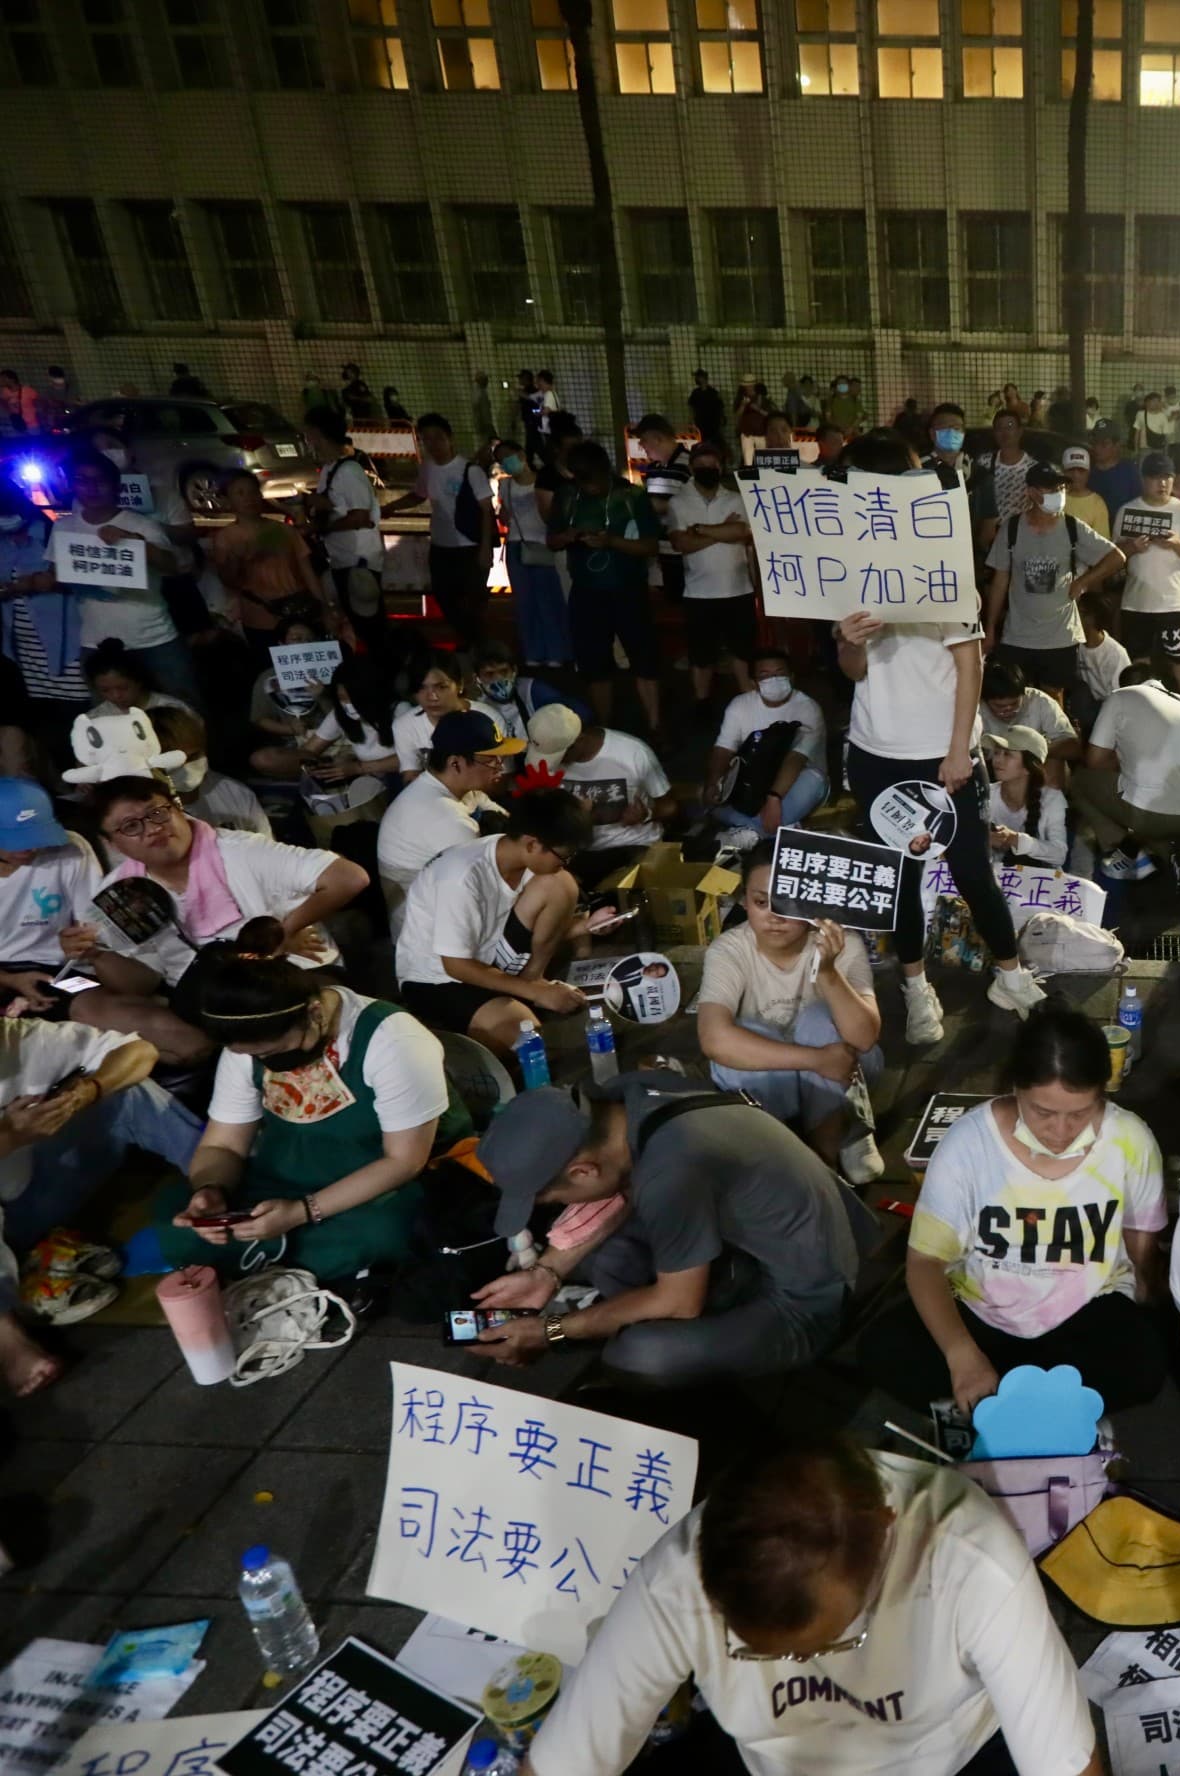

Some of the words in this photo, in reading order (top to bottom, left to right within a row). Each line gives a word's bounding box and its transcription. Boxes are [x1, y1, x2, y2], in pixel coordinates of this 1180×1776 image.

[749, 483, 953, 540] 相信清白
[70, 543, 134, 562] 相信清白
[72, 560, 134, 577] 柯P加油
[767, 552, 957, 605] 柯P加油
[276, 650, 339, 665] 程序要正義
[778, 847, 896, 889] 程序要正義
[776, 874, 893, 915] 司法要公平
[975, 1199, 1119, 1265] STAY
[398, 1387, 673, 1525] 程序要正義
[771, 1675, 905, 1722] COMNT
[298, 1669, 447, 1776] 程序要正義
